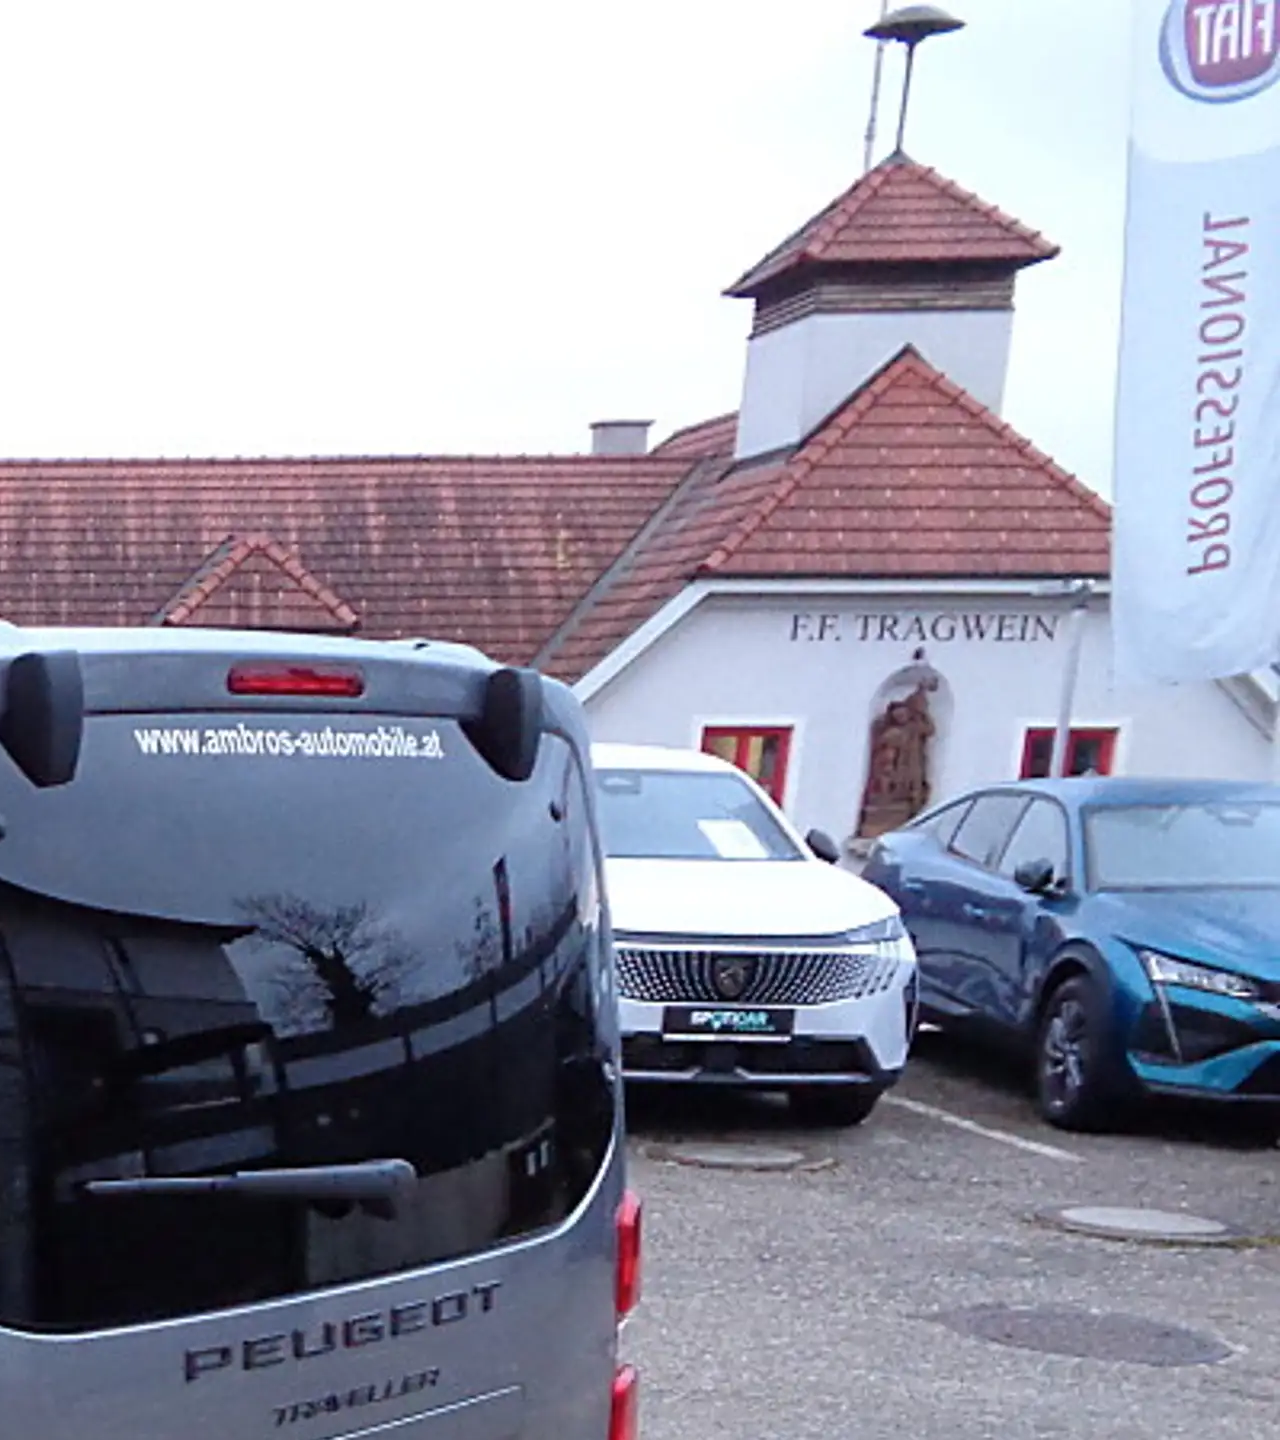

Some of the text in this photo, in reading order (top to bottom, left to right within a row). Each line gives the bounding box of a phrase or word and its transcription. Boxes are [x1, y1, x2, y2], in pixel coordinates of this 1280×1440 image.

[790, 614, 1059, 642] F.F. TRAGWEIN
[134, 724, 445, 758] www.ambros-automobile.at
[184, 1281, 501, 1382] PEUGEOT
[272, 1367, 440, 1427] TRAVELLER
